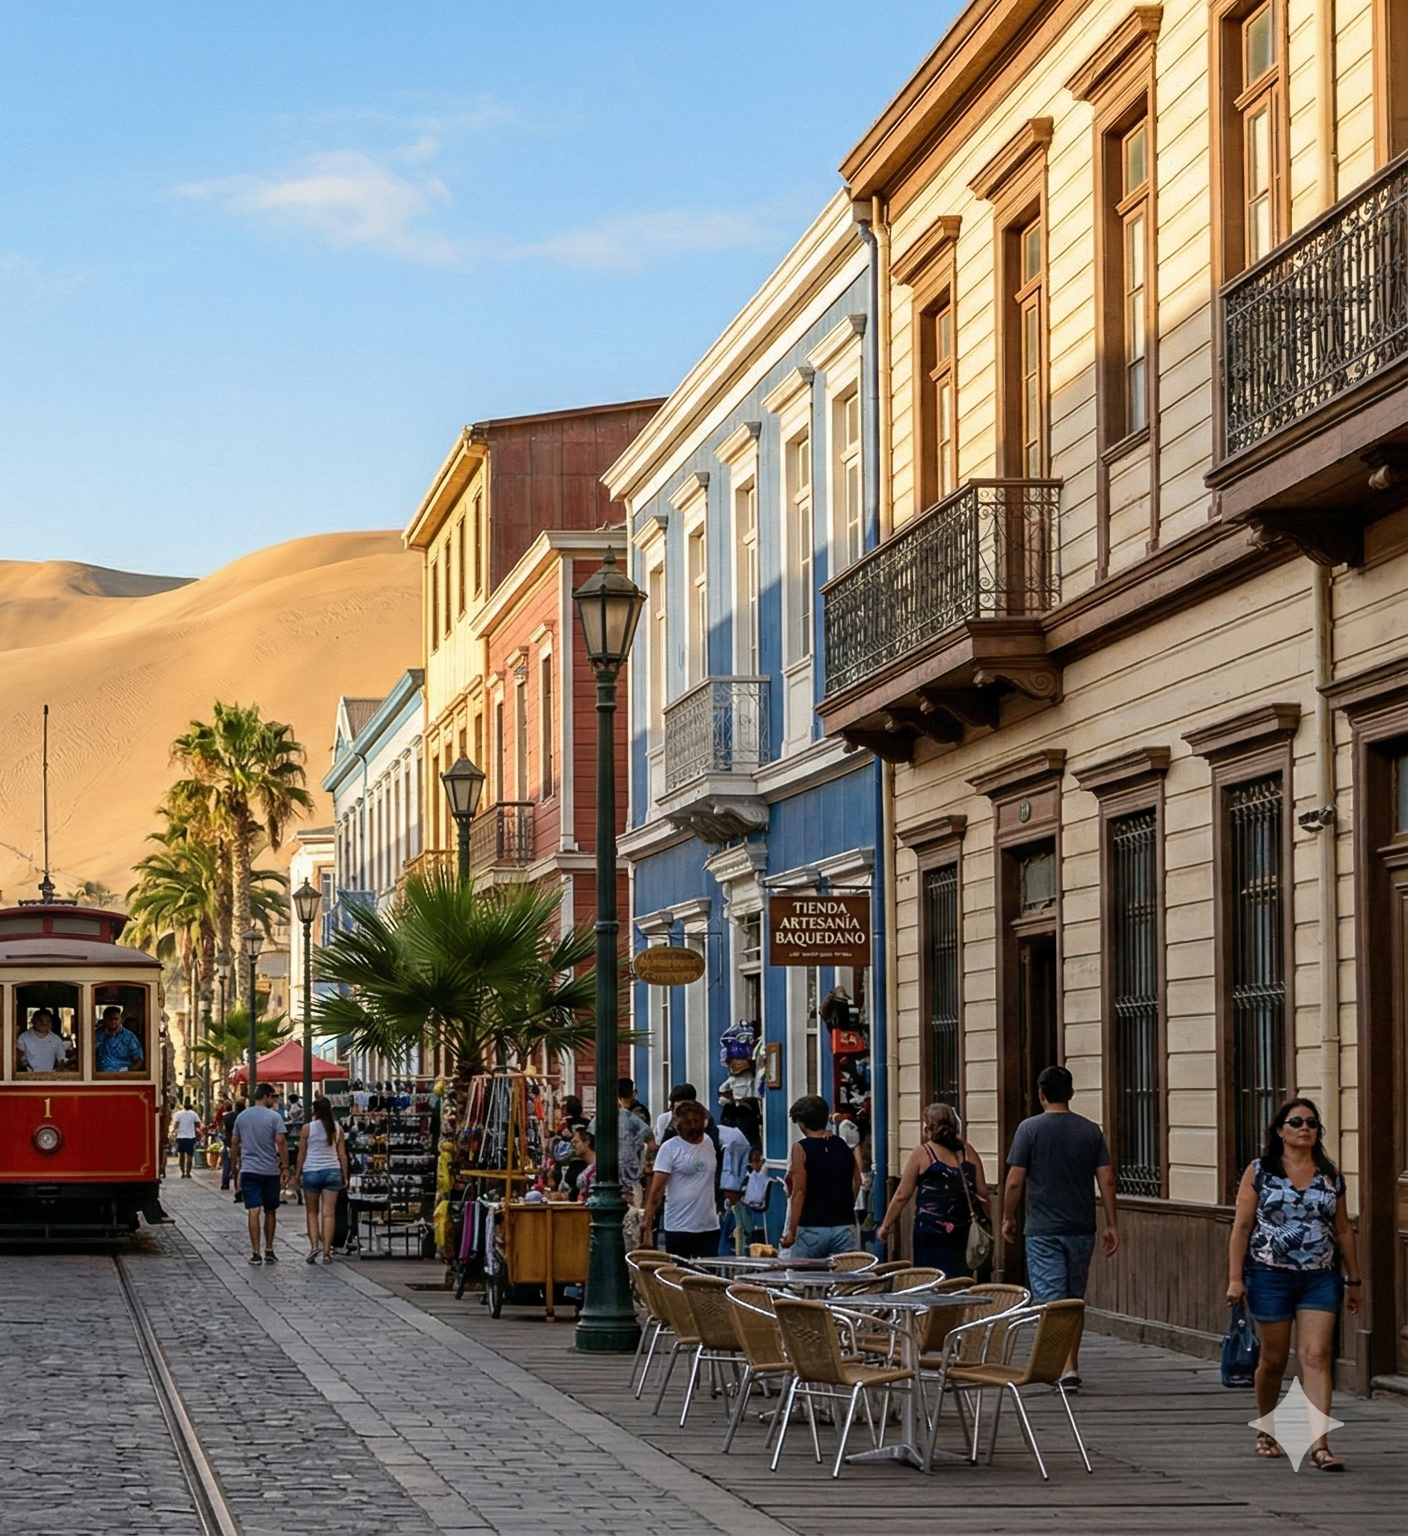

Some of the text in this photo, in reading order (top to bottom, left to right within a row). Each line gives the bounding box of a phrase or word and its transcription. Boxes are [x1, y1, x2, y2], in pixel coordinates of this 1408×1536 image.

[792, 902, 847, 914] TIENDA
[779, 913, 860, 929] ARTESANÍA
[775, 932, 866, 947] BAQUEDANO
[44, 1098, 52, 1117] 1
